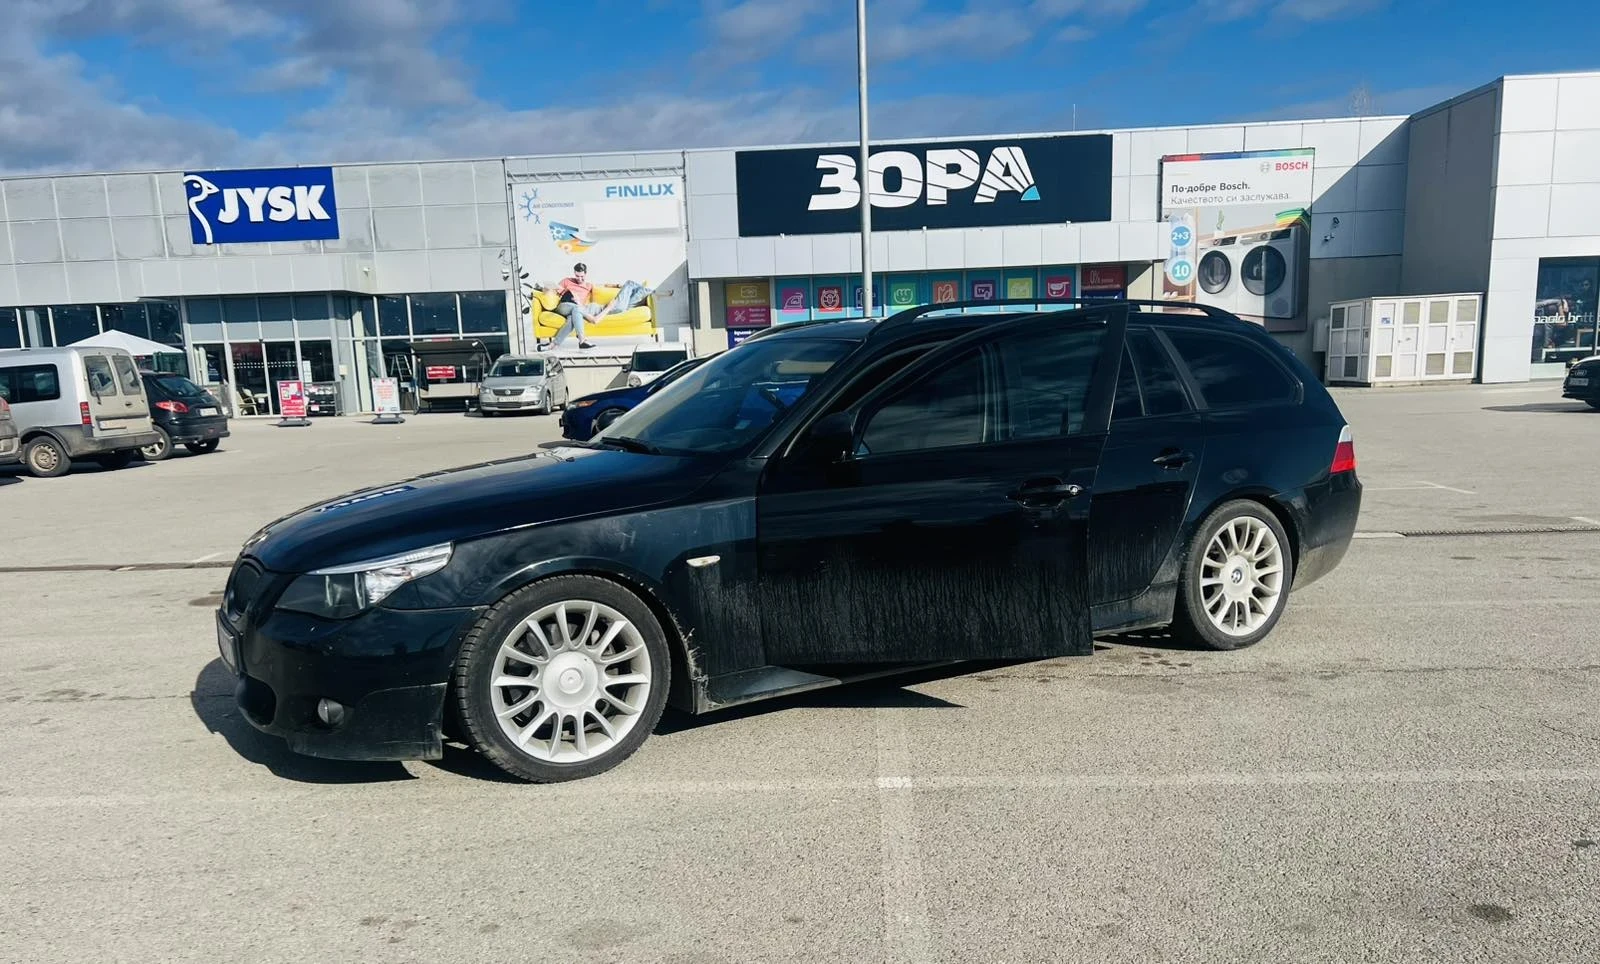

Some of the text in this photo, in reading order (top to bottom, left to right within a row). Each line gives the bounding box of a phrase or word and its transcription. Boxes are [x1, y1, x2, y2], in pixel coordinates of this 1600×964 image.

[1275, 161, 1308, 171] BOSCH
[808, 146, 1041, 210] ЗОРА
[606, 183, 674, 198] FINLUX
[1171, 181, 1250, 194] По-добре Bosch.
[218, 184, 330, 223] JYSK
[1171, 195, 1223, 205] Качеството
[1172, 232, 1189, 241] 2+3
[1174, 264, 1189, 277] 10
